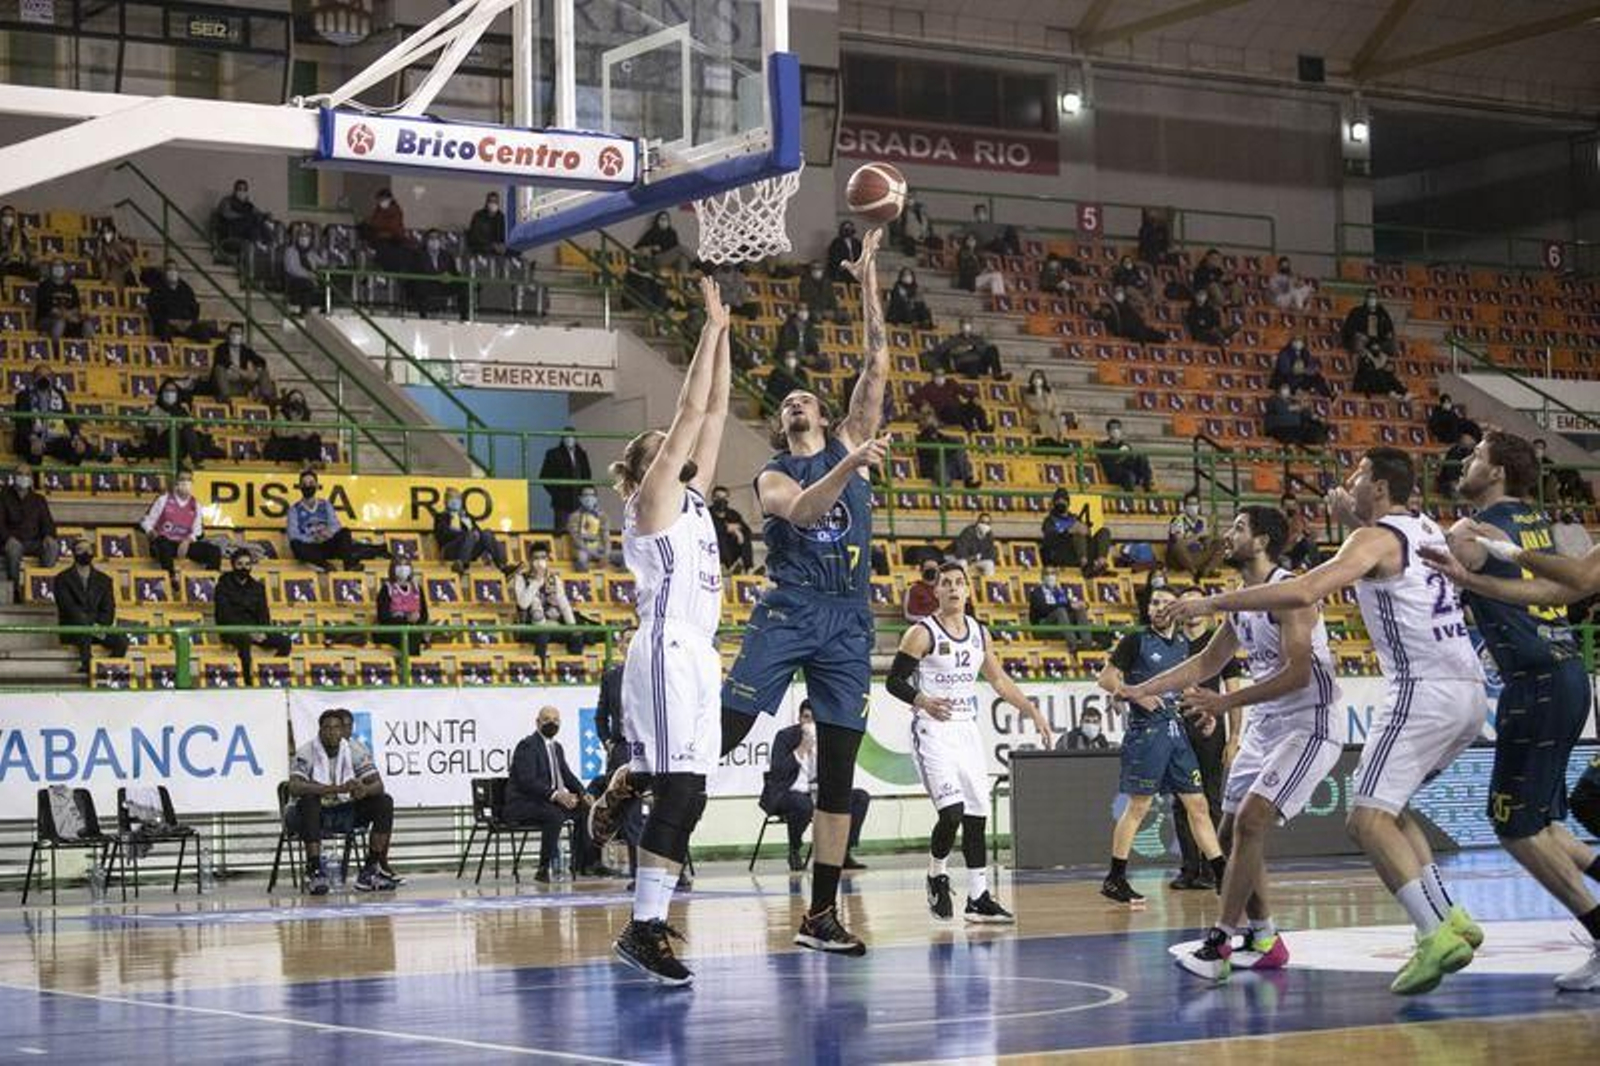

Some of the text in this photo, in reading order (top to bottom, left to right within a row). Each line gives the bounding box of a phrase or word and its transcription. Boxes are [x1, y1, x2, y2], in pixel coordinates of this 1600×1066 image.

[396, 129, 581, 171] BricoCentro
[836, 127, 1031, 167] GRADA RIO
[1082, 206, 1098, 231] 5
[1549, 245, 1561, 269] 6
[481, 366, 604, 389] EMERXENCIA
[210, 480, 493, 522] PISA RO
[1078, 503, 1094, 529] 4
[847, 545, 861, 571] 7
[954, 650, 971, 668] 12
[384, 719, 477, 746] XUNTA
[0, 724, 264, 782] ABANCA
[386, 748, 514, 777] DE GALICI
